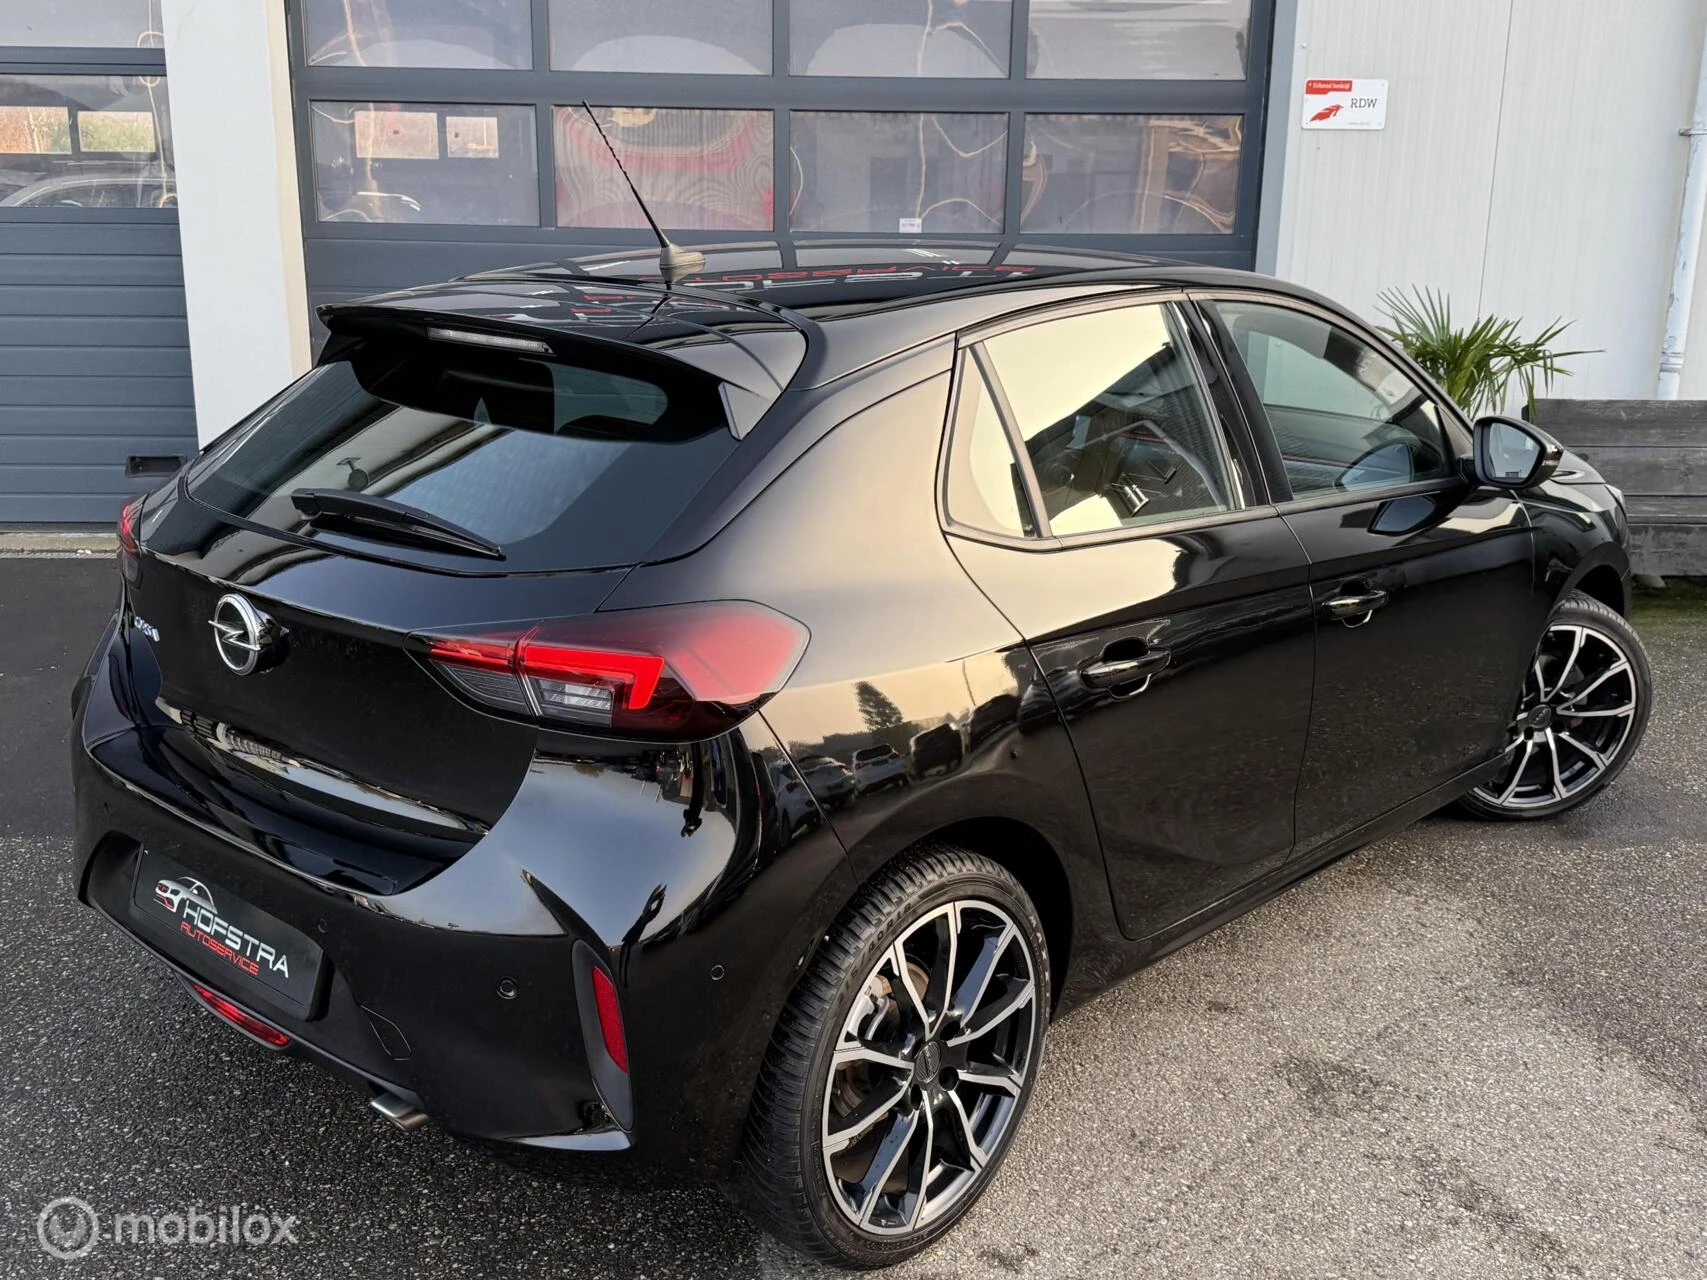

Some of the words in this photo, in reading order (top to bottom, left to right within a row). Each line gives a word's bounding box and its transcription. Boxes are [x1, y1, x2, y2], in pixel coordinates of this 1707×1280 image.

[1350, 97, 1378, 109] RDW
[180, 921, 261, 976] AUTOSERVICE
[182, 899, 289, 978] HOFSTRA
